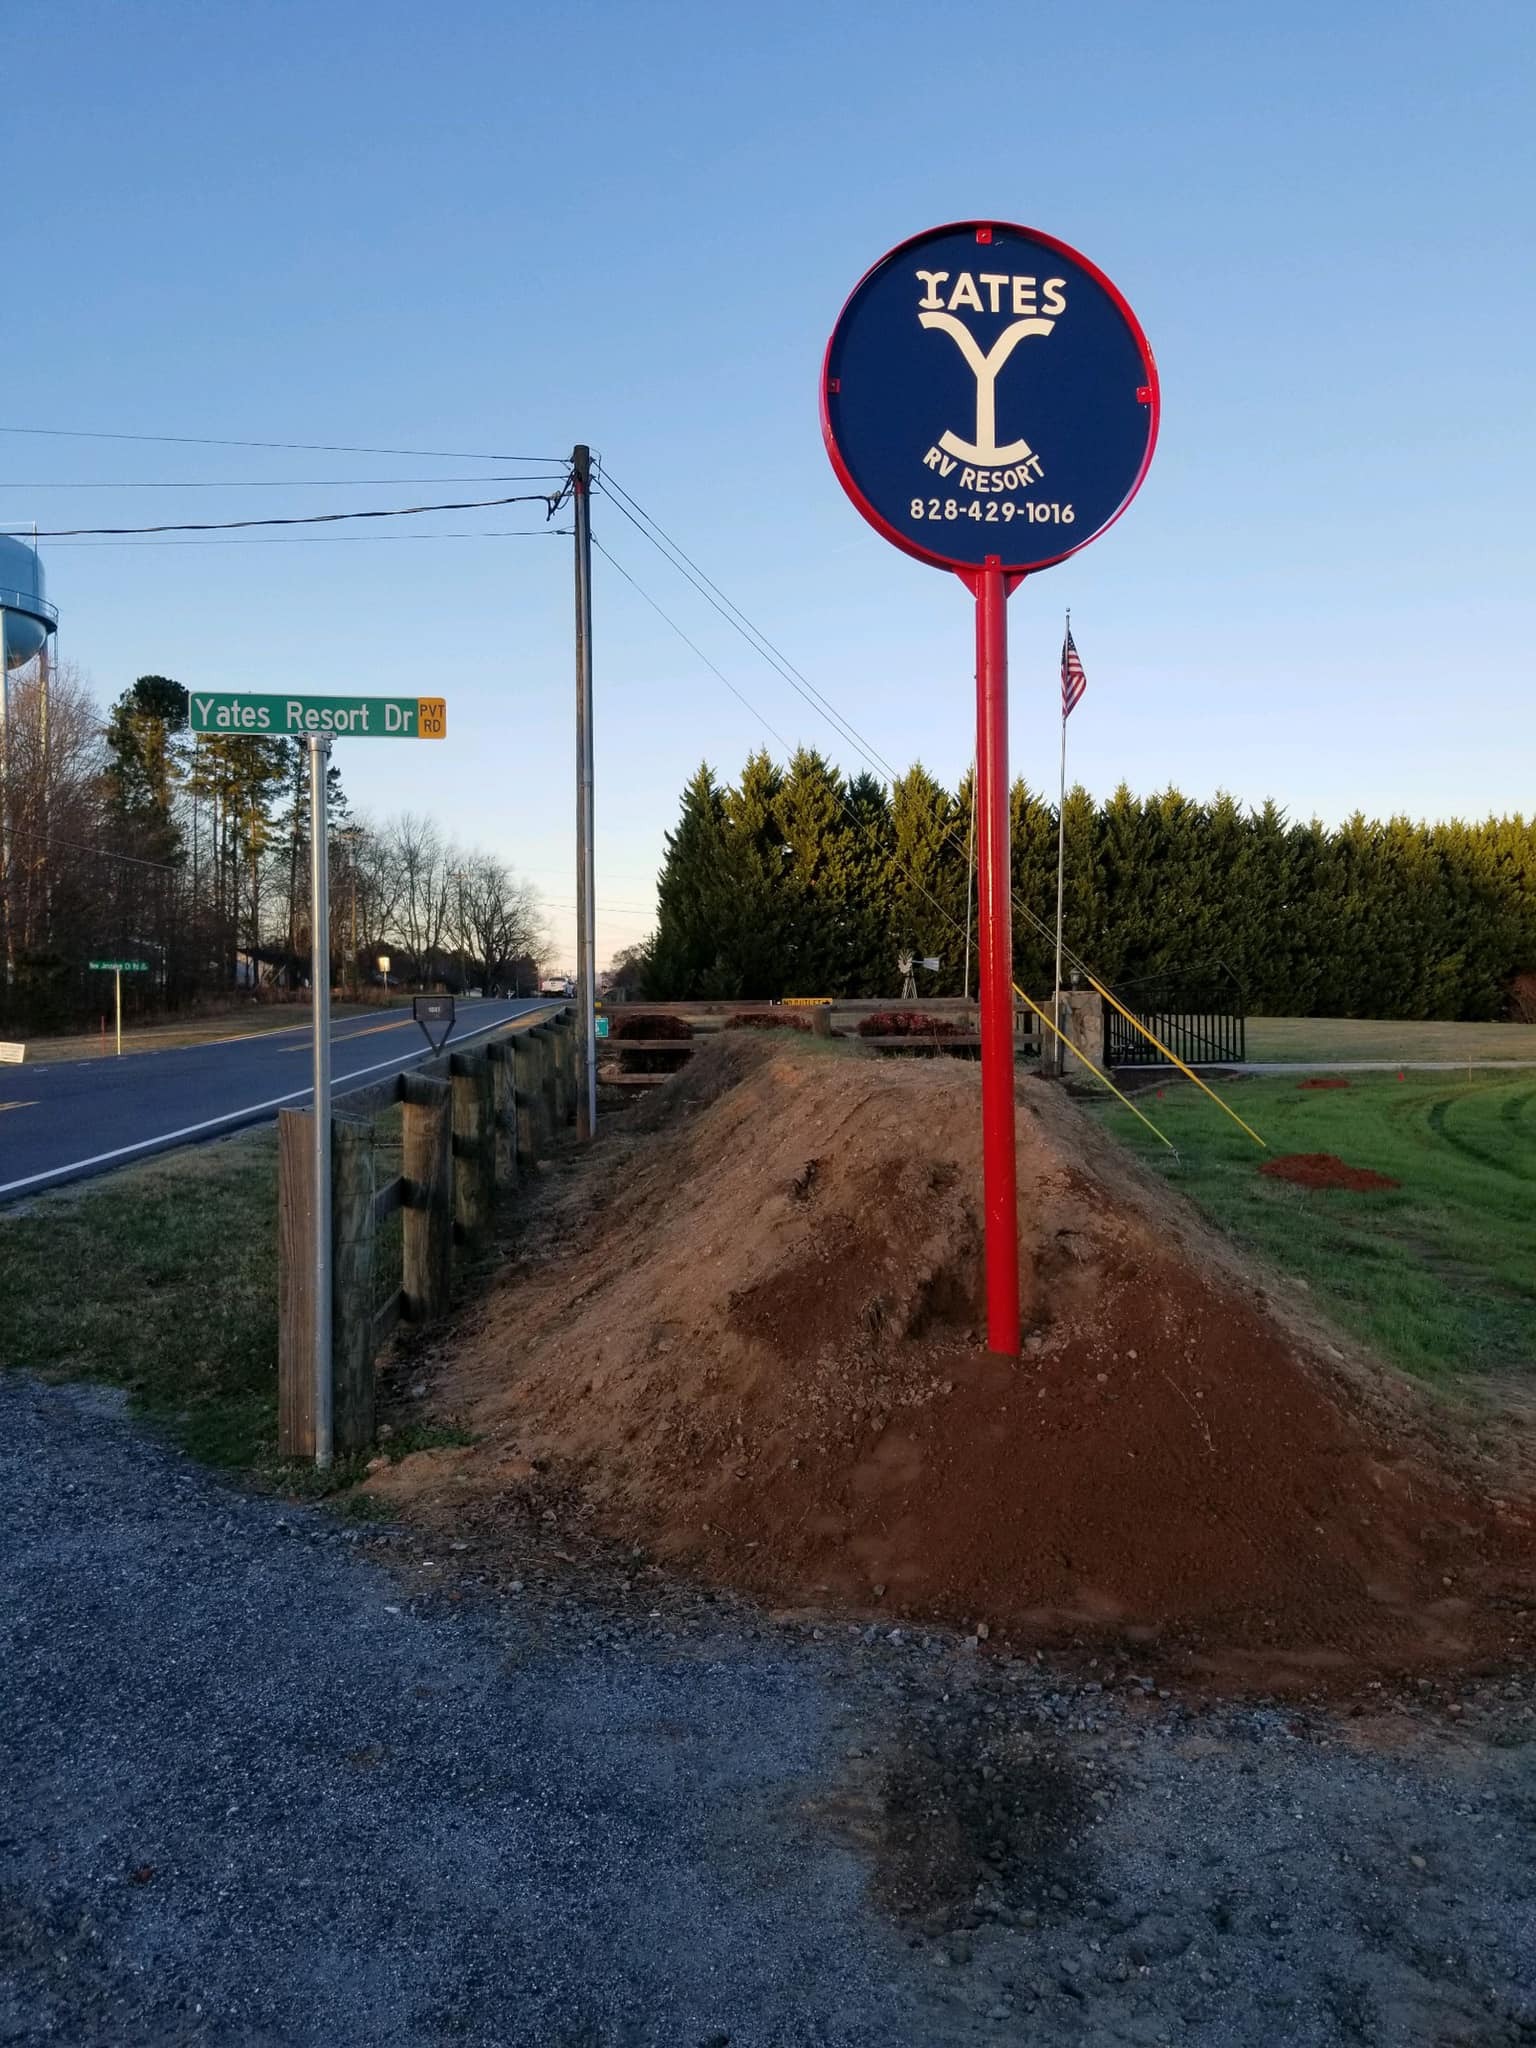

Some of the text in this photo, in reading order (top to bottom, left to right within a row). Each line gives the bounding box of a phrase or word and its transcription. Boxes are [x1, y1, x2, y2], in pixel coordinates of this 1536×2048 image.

[915, 270, 1067, 315] YATES
[922, 446, 1045, 493] RV RESORT
[910, 498, 1075, 524] 828-429-1016
[195, 698, 413, 732] Yates Resort Dr
[420, 704, 445, 718] PVT
[424, 719, 441, 733] RD
